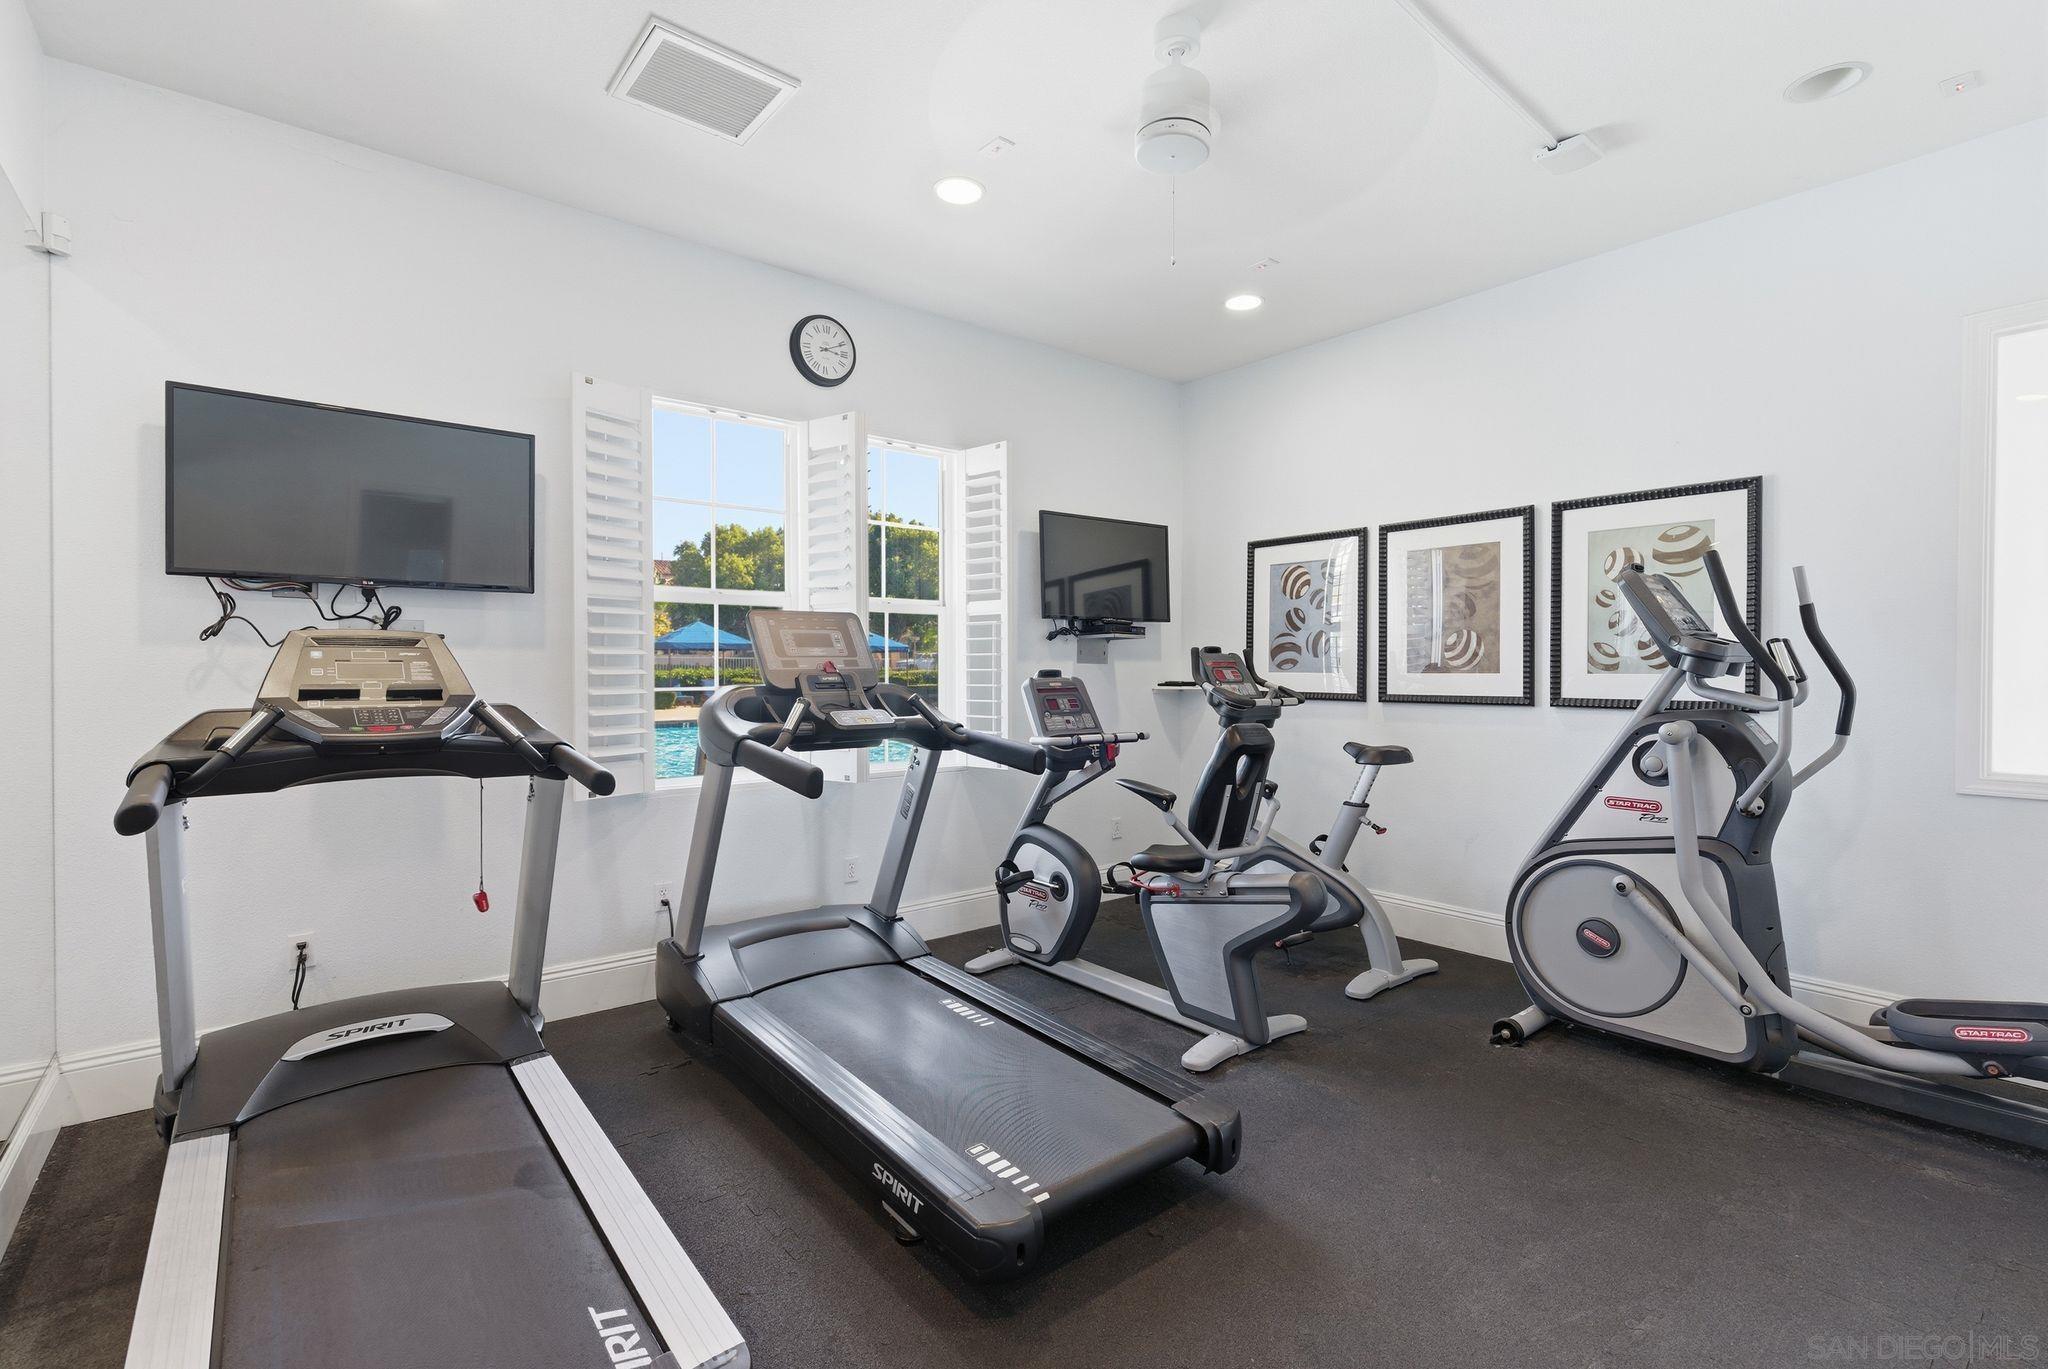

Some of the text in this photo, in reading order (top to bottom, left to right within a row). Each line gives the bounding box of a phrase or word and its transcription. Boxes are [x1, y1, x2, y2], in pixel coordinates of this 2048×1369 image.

[1607, 799, 1631, 807] STAR
[325, 1018, 411, 1042] SPIRIT
[871, 1162, 924, 1214] SPIRIT
